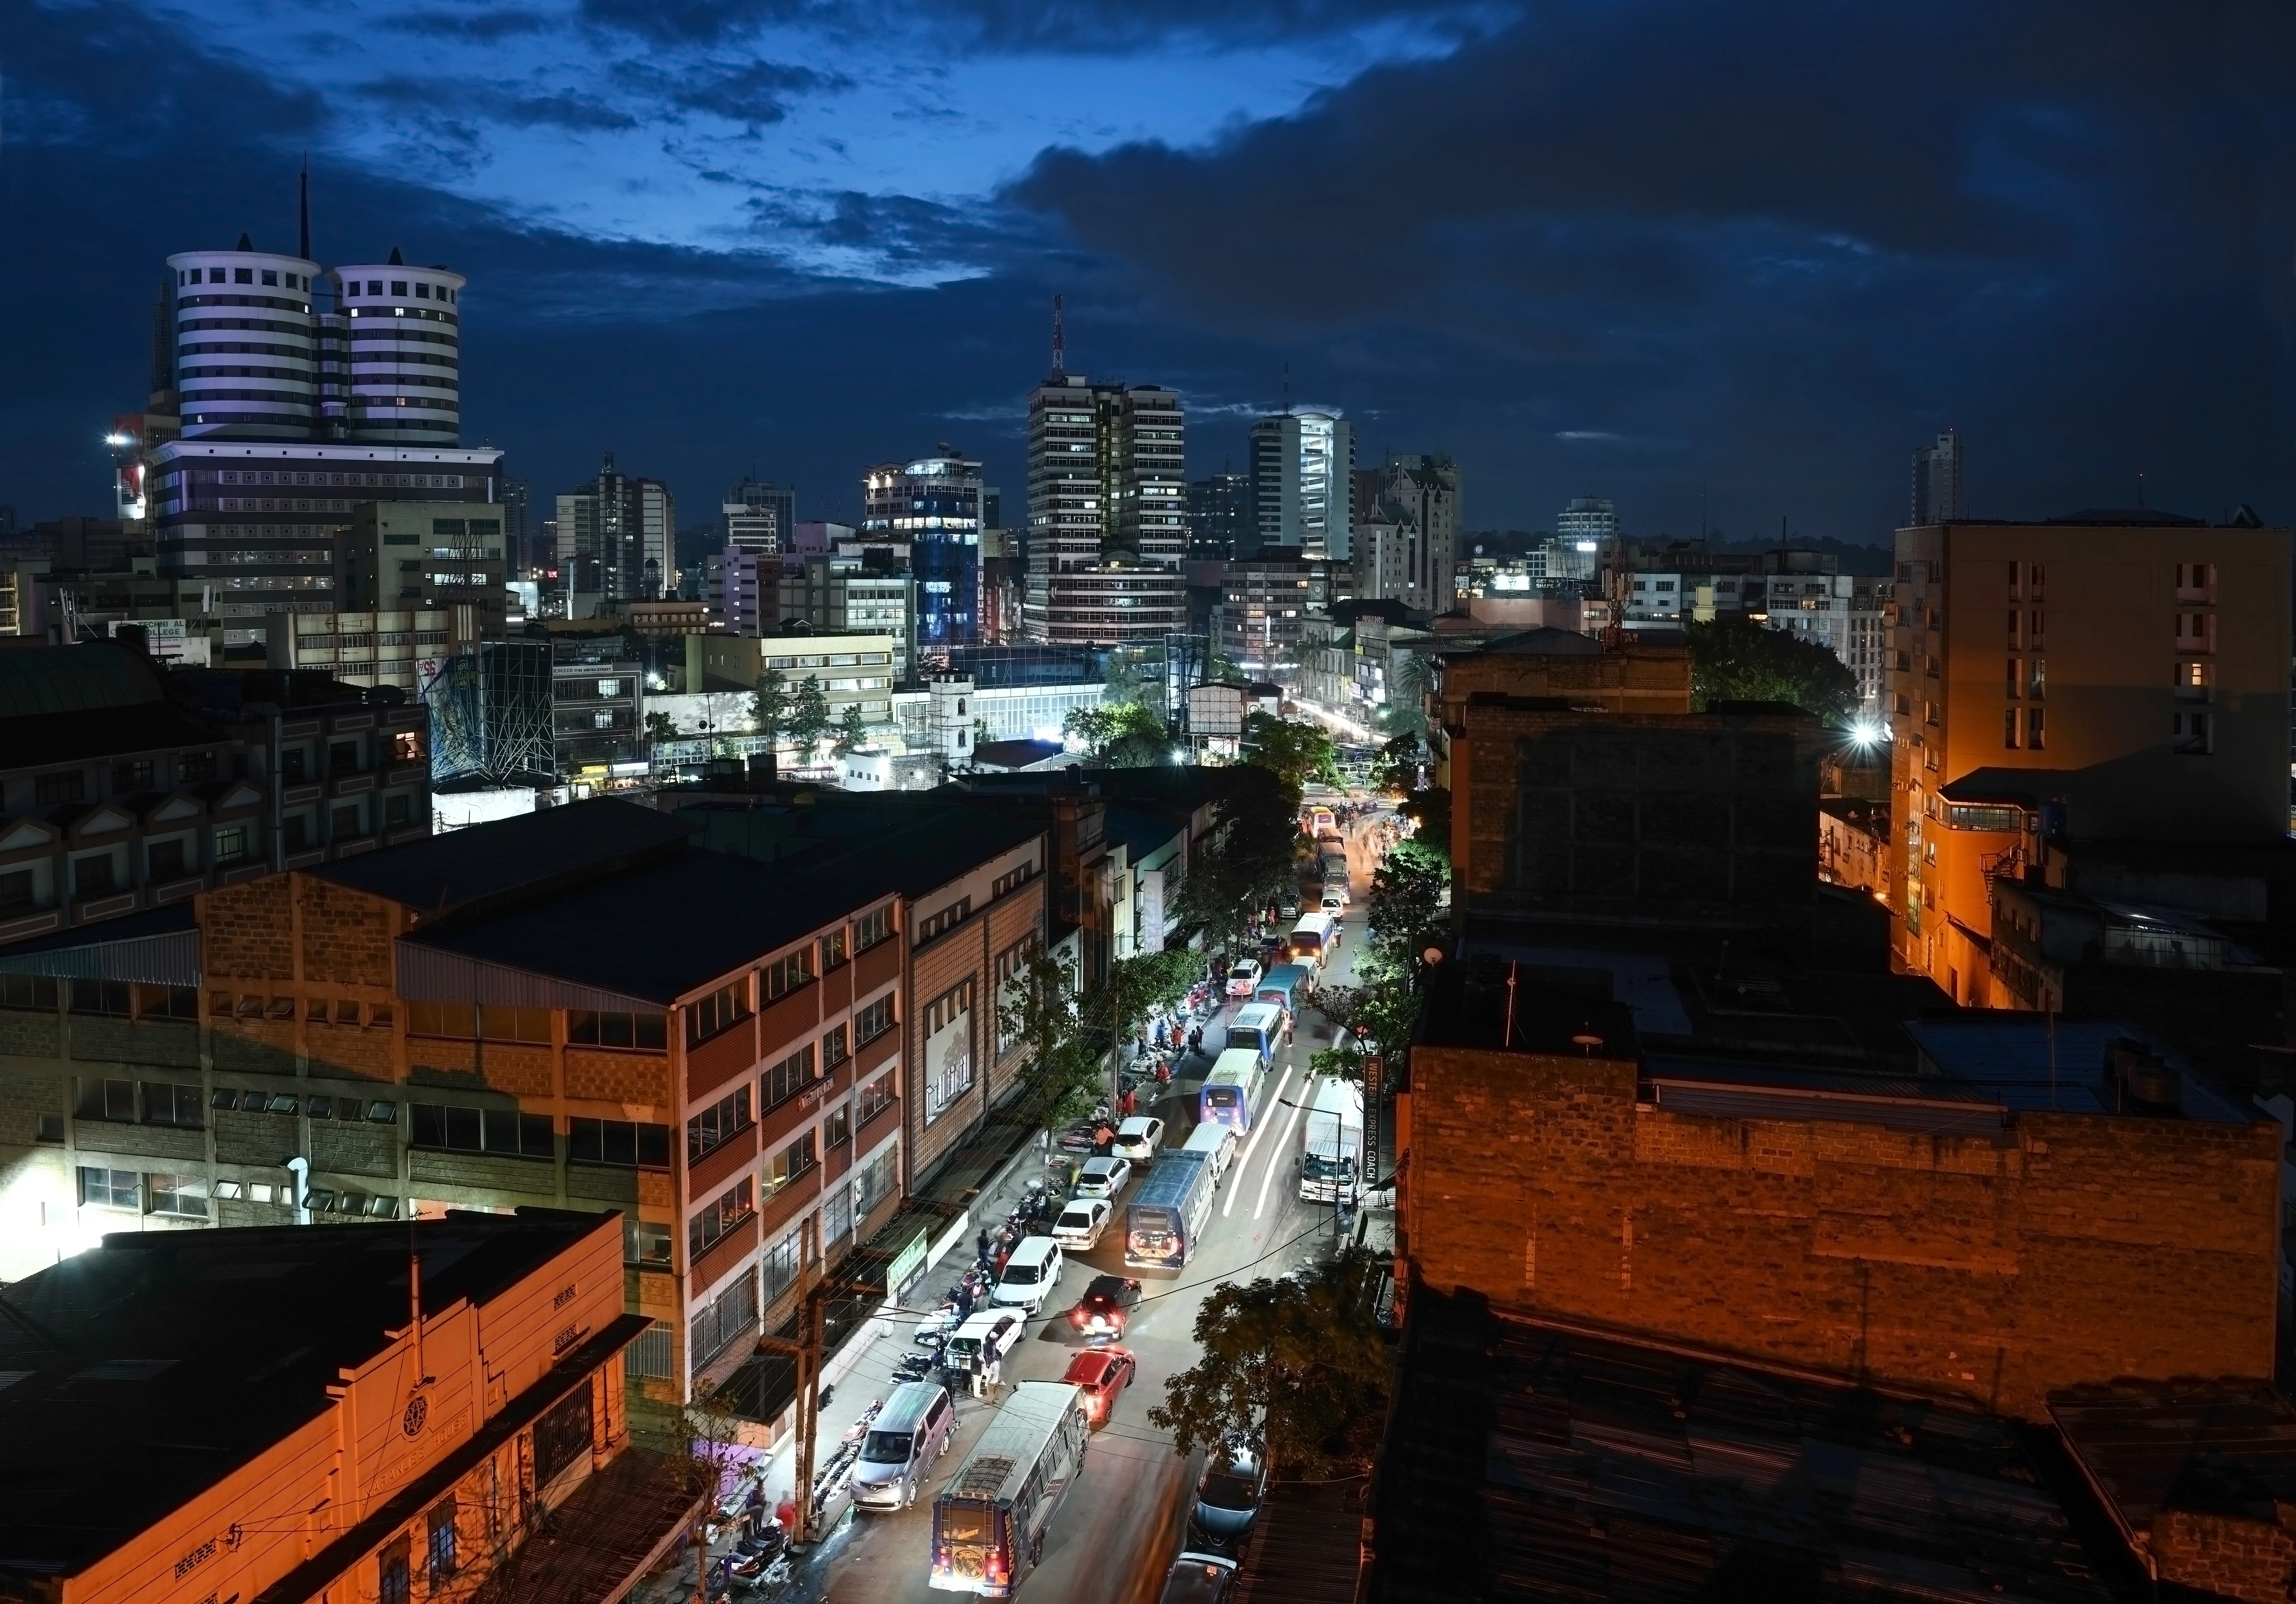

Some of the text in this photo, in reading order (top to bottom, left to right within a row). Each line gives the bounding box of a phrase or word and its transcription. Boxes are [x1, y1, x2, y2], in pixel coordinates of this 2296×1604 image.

[1145, 876, 1155, 952] ESTLADY
[1367, 1063, 1377, 1178] WESTERN EXPRESS COACH
[900, 1265, 925, 1297] PUMA EXPRESS
[365, 1415, 466, 1499] NARANJEE HOUSE
[1039, 1428, 1060, 1470] REBEL
[958, 1528, 979, 1540] RESIST
[1005, 1513, 1014, 1576] SHUJAA
